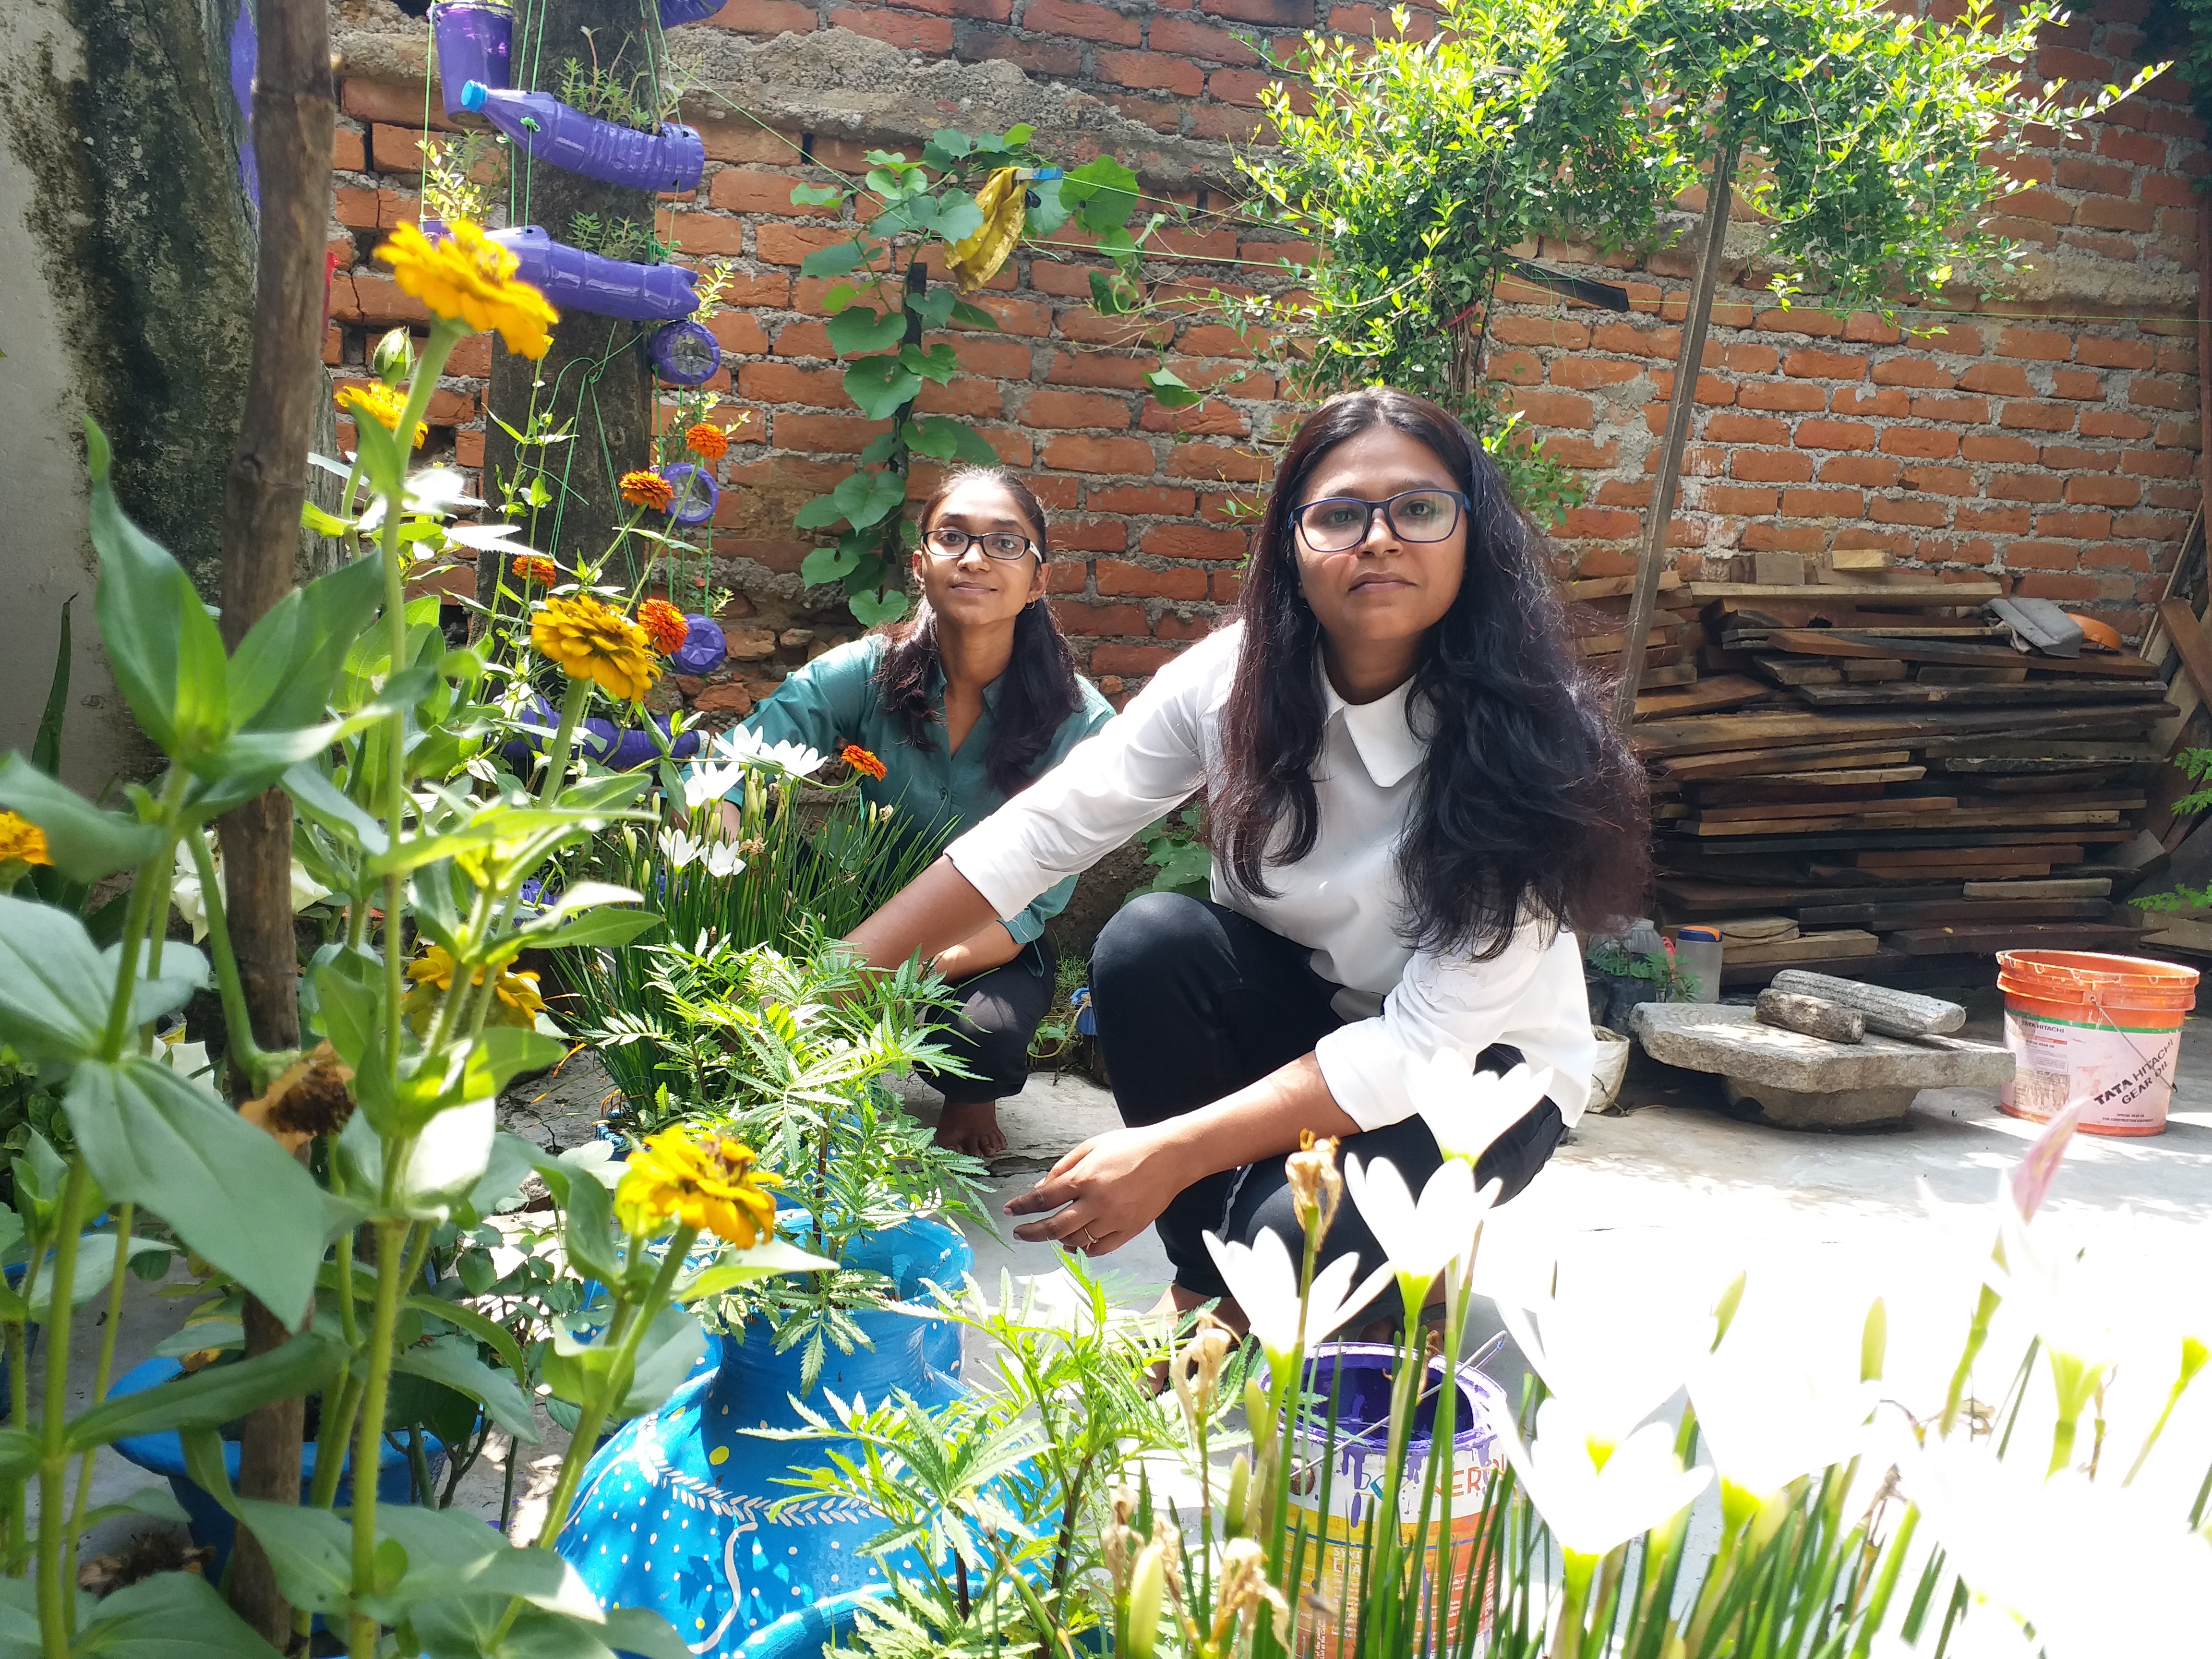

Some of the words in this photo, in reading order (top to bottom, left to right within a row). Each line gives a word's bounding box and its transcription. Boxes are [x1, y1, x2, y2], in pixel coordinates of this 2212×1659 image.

[2037, 1024, 2064, 1033] HITACHI
[2093, 1079, 2133, 1105] TATA
[2132, 1039, 2174, 1082] HITACHI
[2121, 1077, 2153, 1104] GEAR
